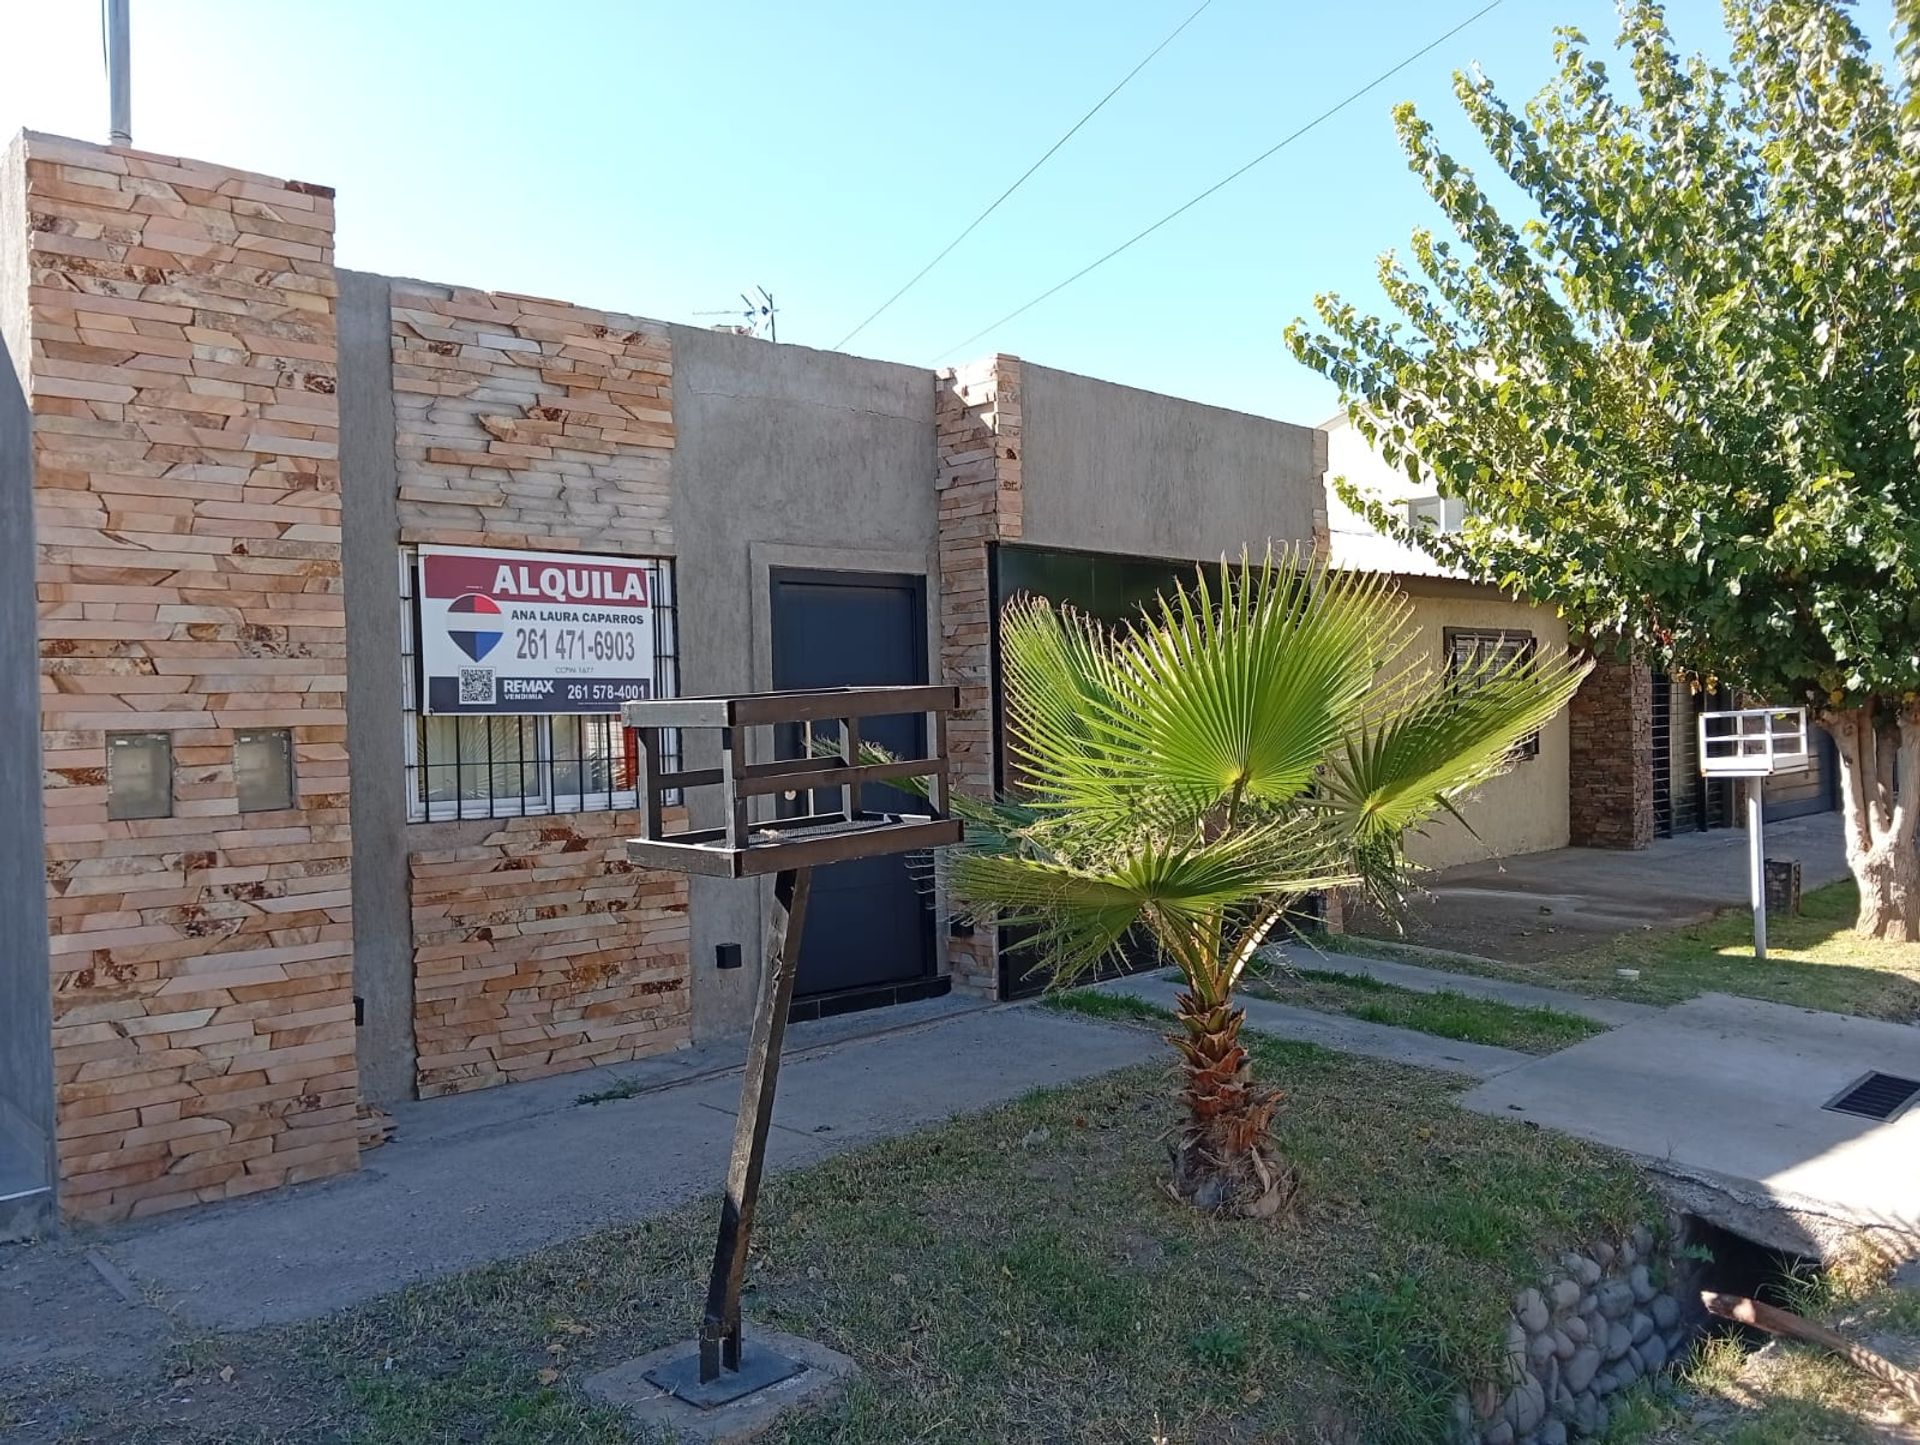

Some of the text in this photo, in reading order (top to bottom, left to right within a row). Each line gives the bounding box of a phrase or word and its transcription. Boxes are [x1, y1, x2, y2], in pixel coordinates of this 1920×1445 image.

[492, 565, 645, 601] ALQUILA
[511, 610, 644, 625] ANA LAURA CAPARROS
[516, 628, 635, 661] 261 471-6903
[567, 684, 646, 700] 261 578-4001
